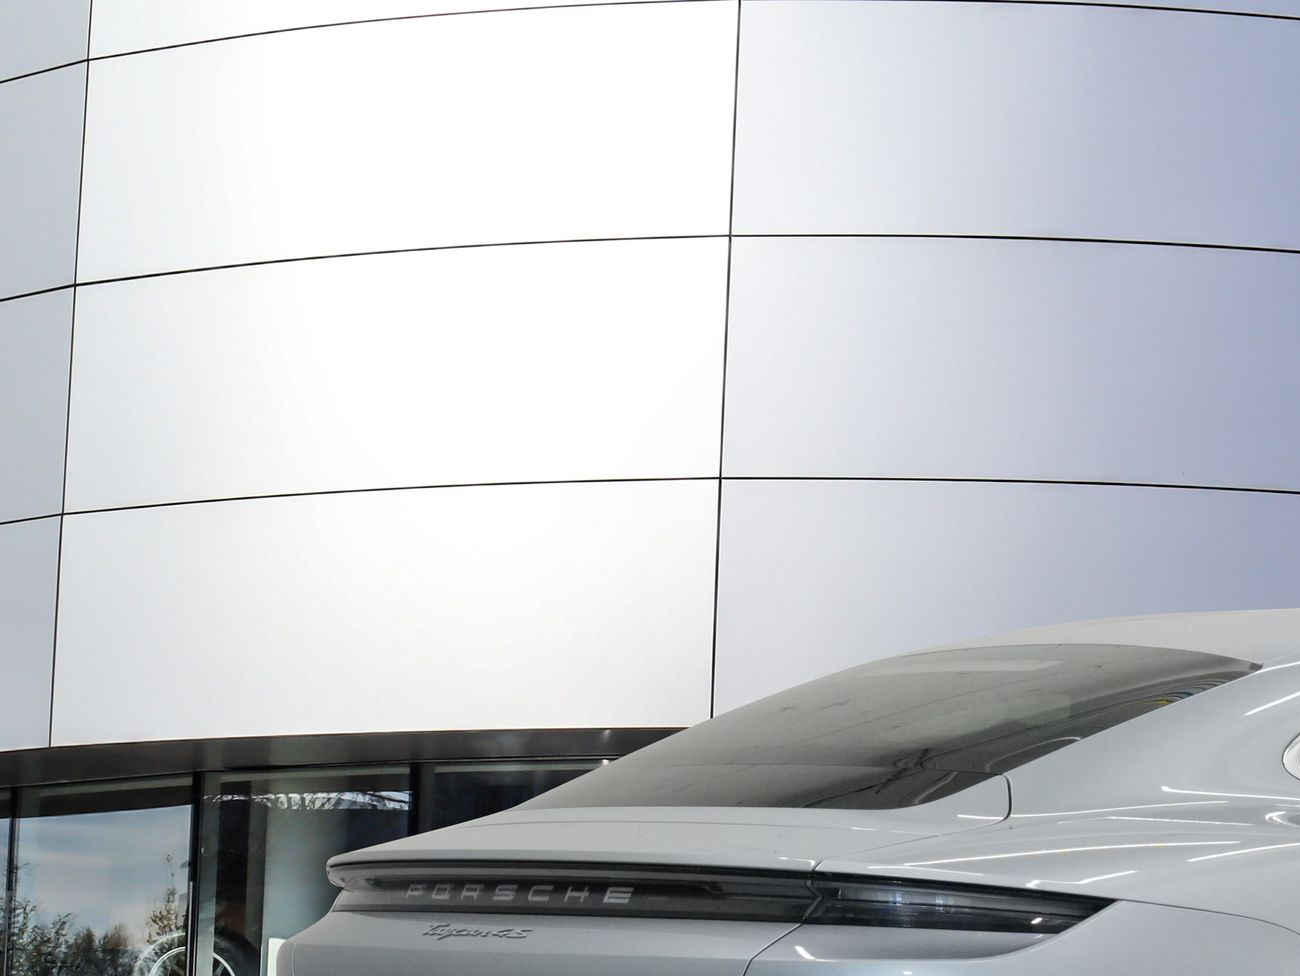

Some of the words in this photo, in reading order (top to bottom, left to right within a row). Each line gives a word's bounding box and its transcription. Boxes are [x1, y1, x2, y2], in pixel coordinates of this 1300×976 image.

[404, 883, 634, 904] PORSCHE
[422, 923, 490, 940] Taycan
[491, 928, 533, 939] 4S
